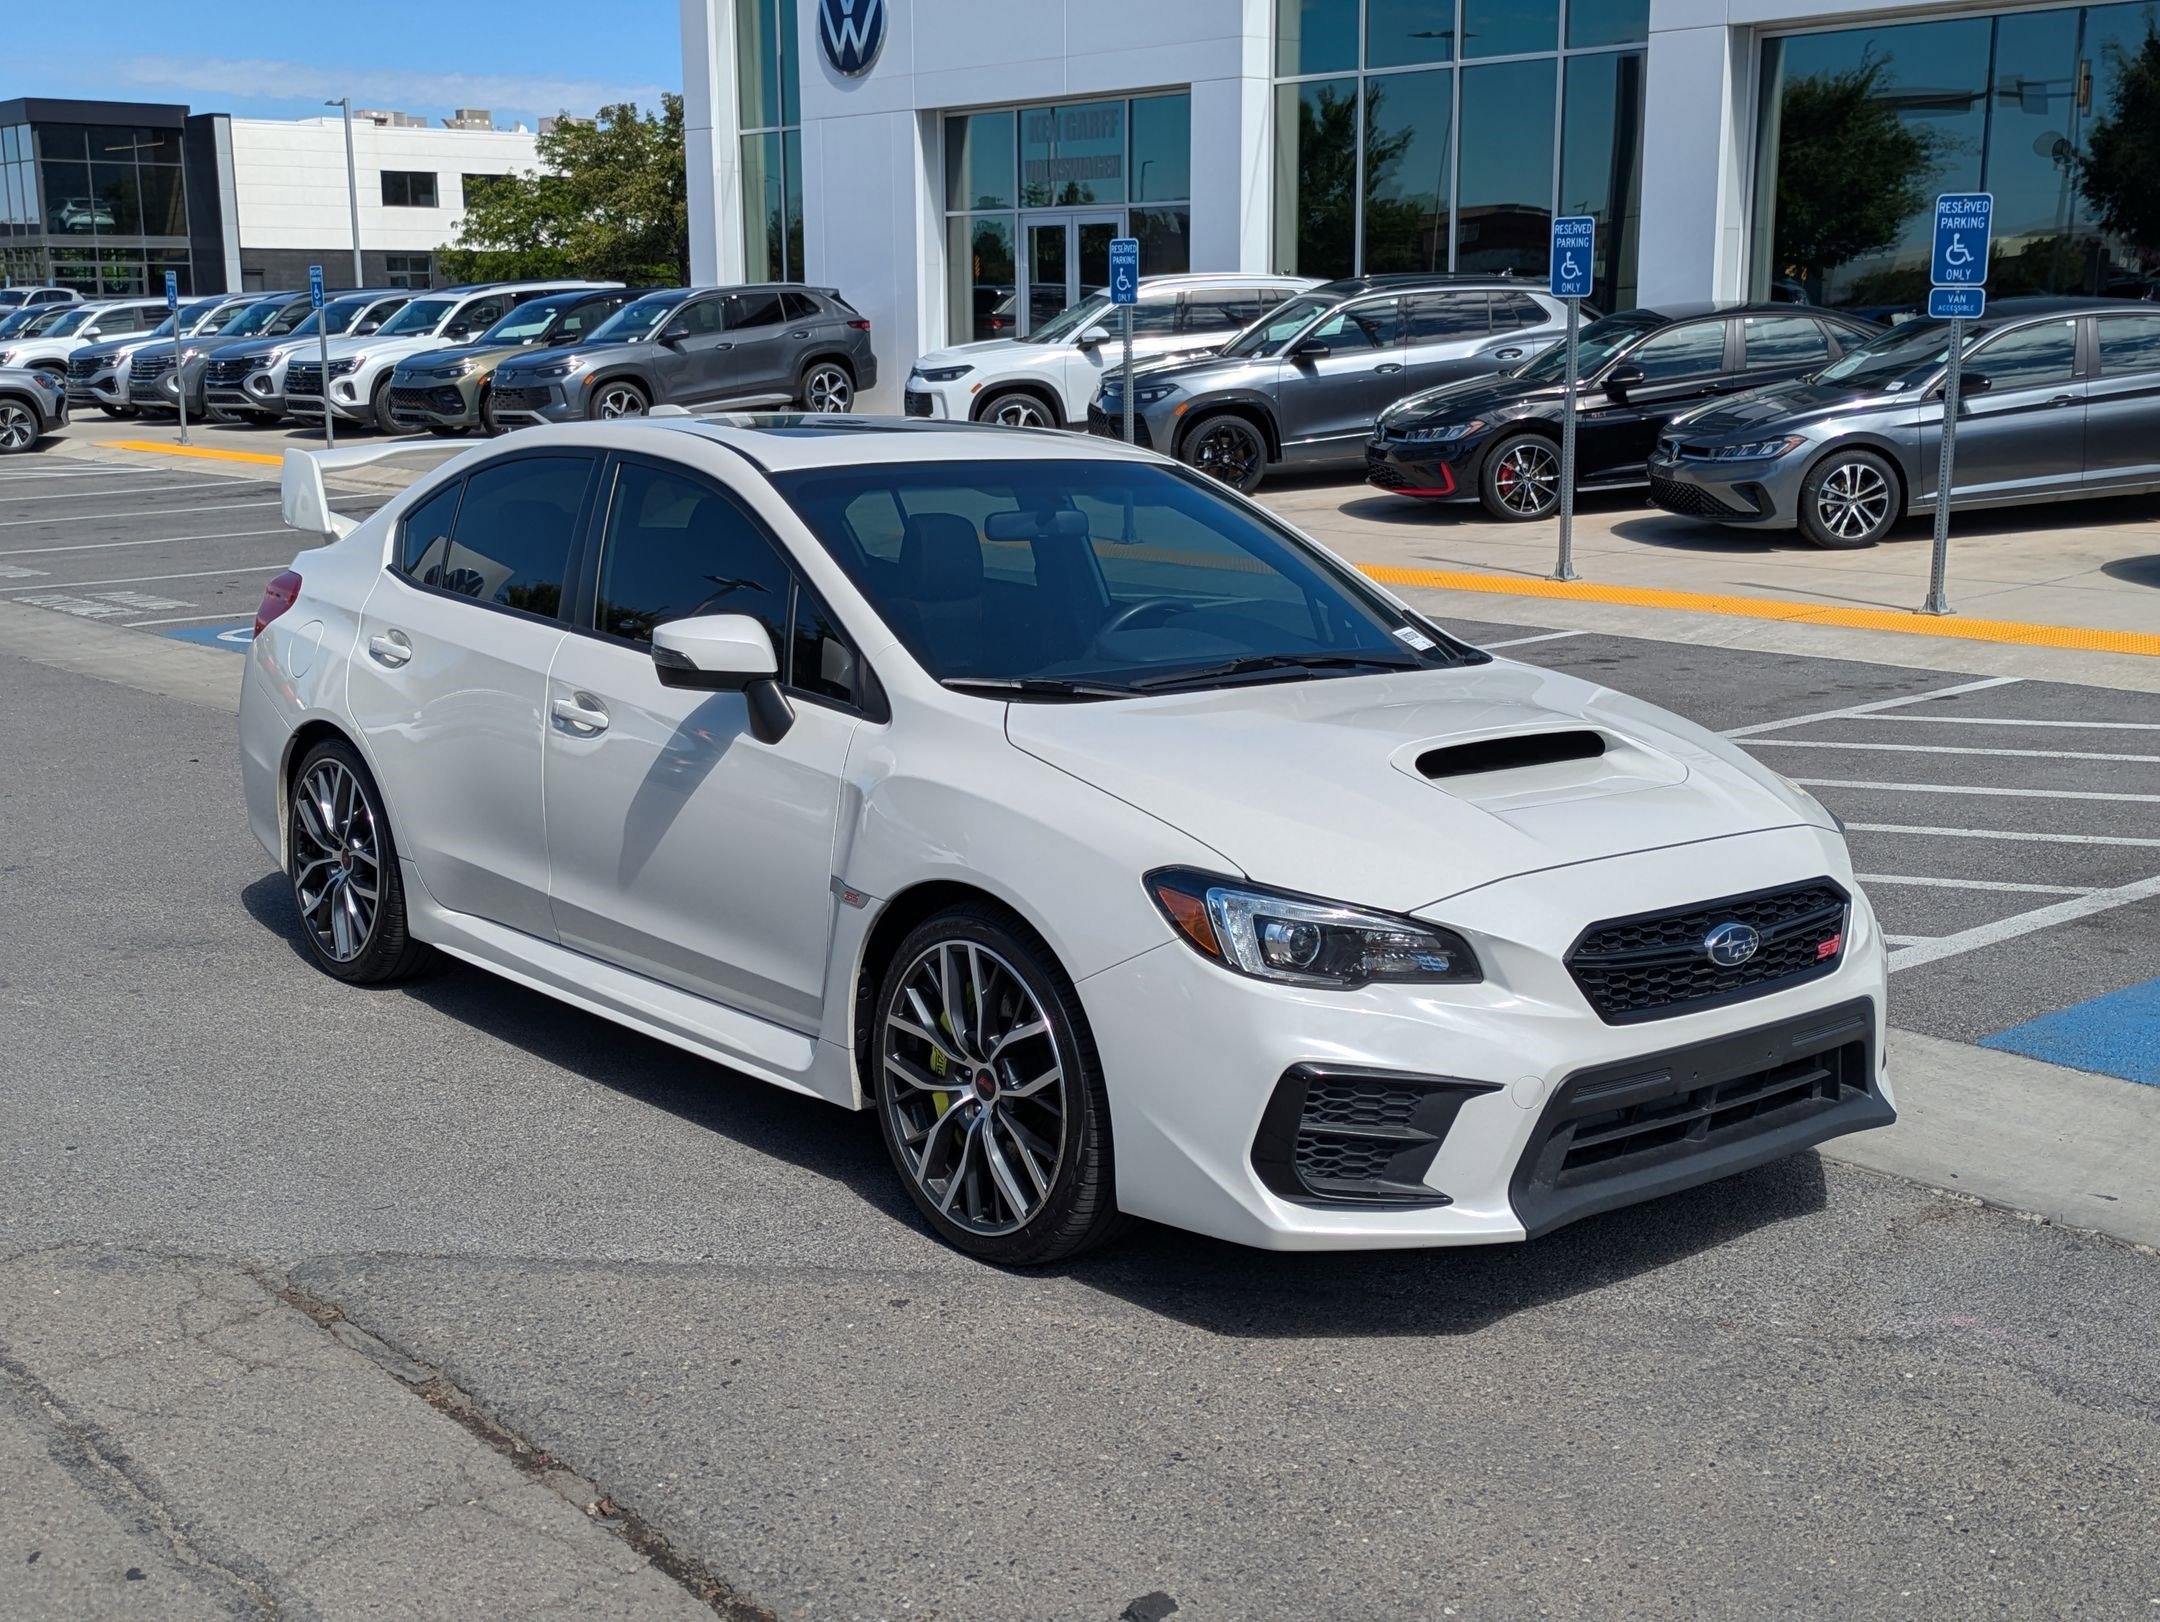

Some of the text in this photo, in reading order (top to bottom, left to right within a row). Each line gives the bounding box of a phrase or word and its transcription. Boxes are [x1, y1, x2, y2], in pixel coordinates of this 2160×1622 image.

[1064, 109, 1119, 142] GARFF
[1939, 201, 1989, 213] RESERVED
[1555, 223, 1592, 234] RESERVED
[1941, 217, 1985, 229] PARKING
[1556, 237, 1589, 248] PARKING
[1111, 244, 1137, 253] RESERVED
[1112, 256, 1135, 264] PARKING
[1946, 269, 1971, 280] ONLY
[1561, 282, 1580, 292] ONLY
[1948, 295, 1966, 303] VAN
